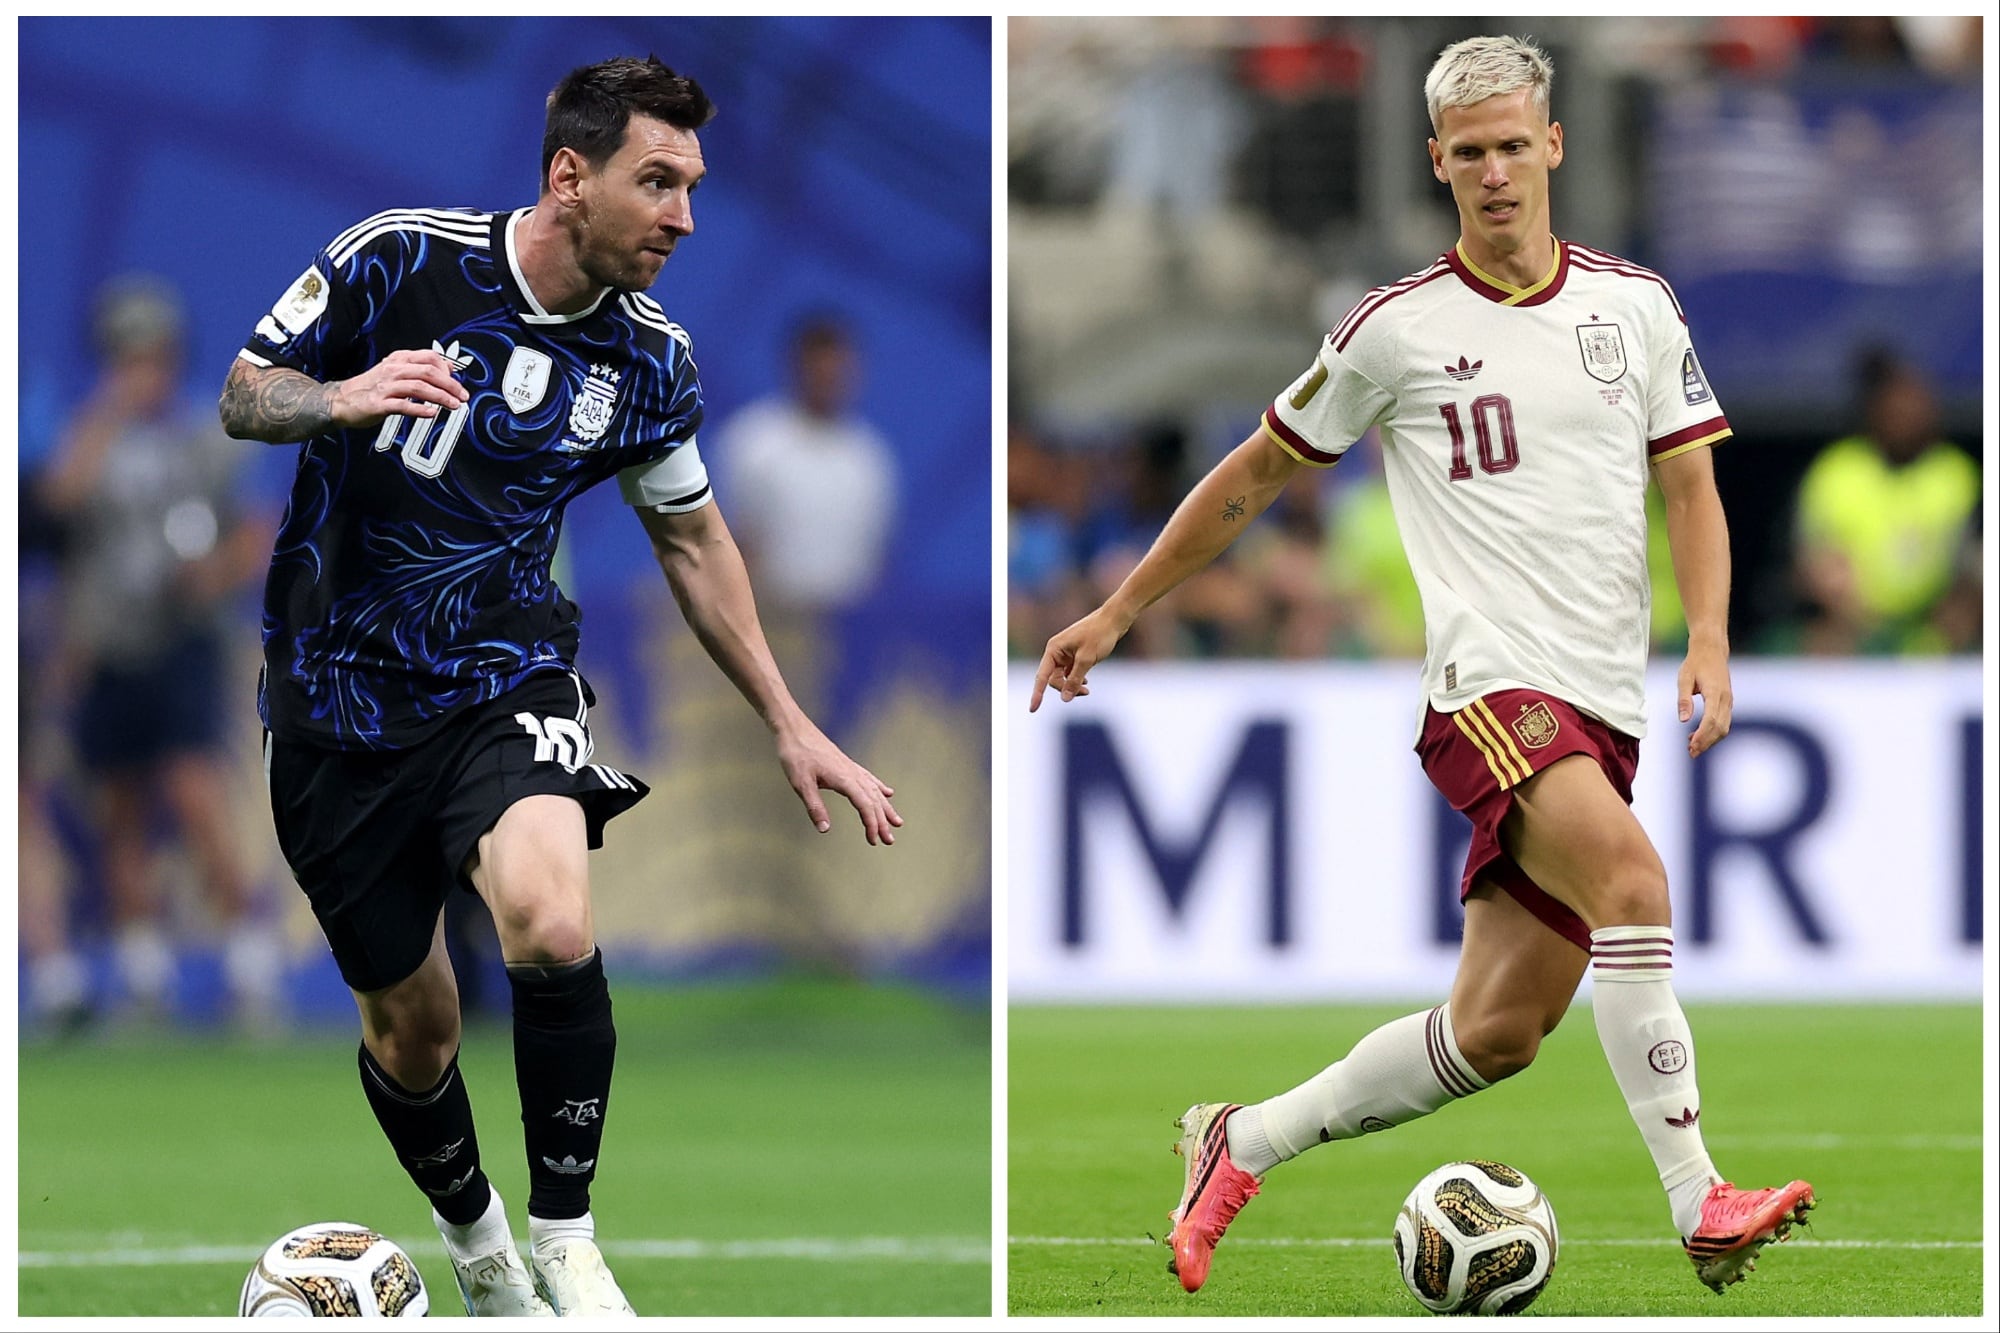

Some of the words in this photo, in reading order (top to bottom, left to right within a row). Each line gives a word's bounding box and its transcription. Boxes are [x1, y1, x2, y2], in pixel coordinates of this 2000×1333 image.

[513, 387, 532, 400] FIFA
[1438, 392, 1521, 483] 10
[513, 711, 588, 775] 10
[1438, 1199, 1499, 1232] ATLANTA
[1464, 1199, 1504, 1223] JERSEY
